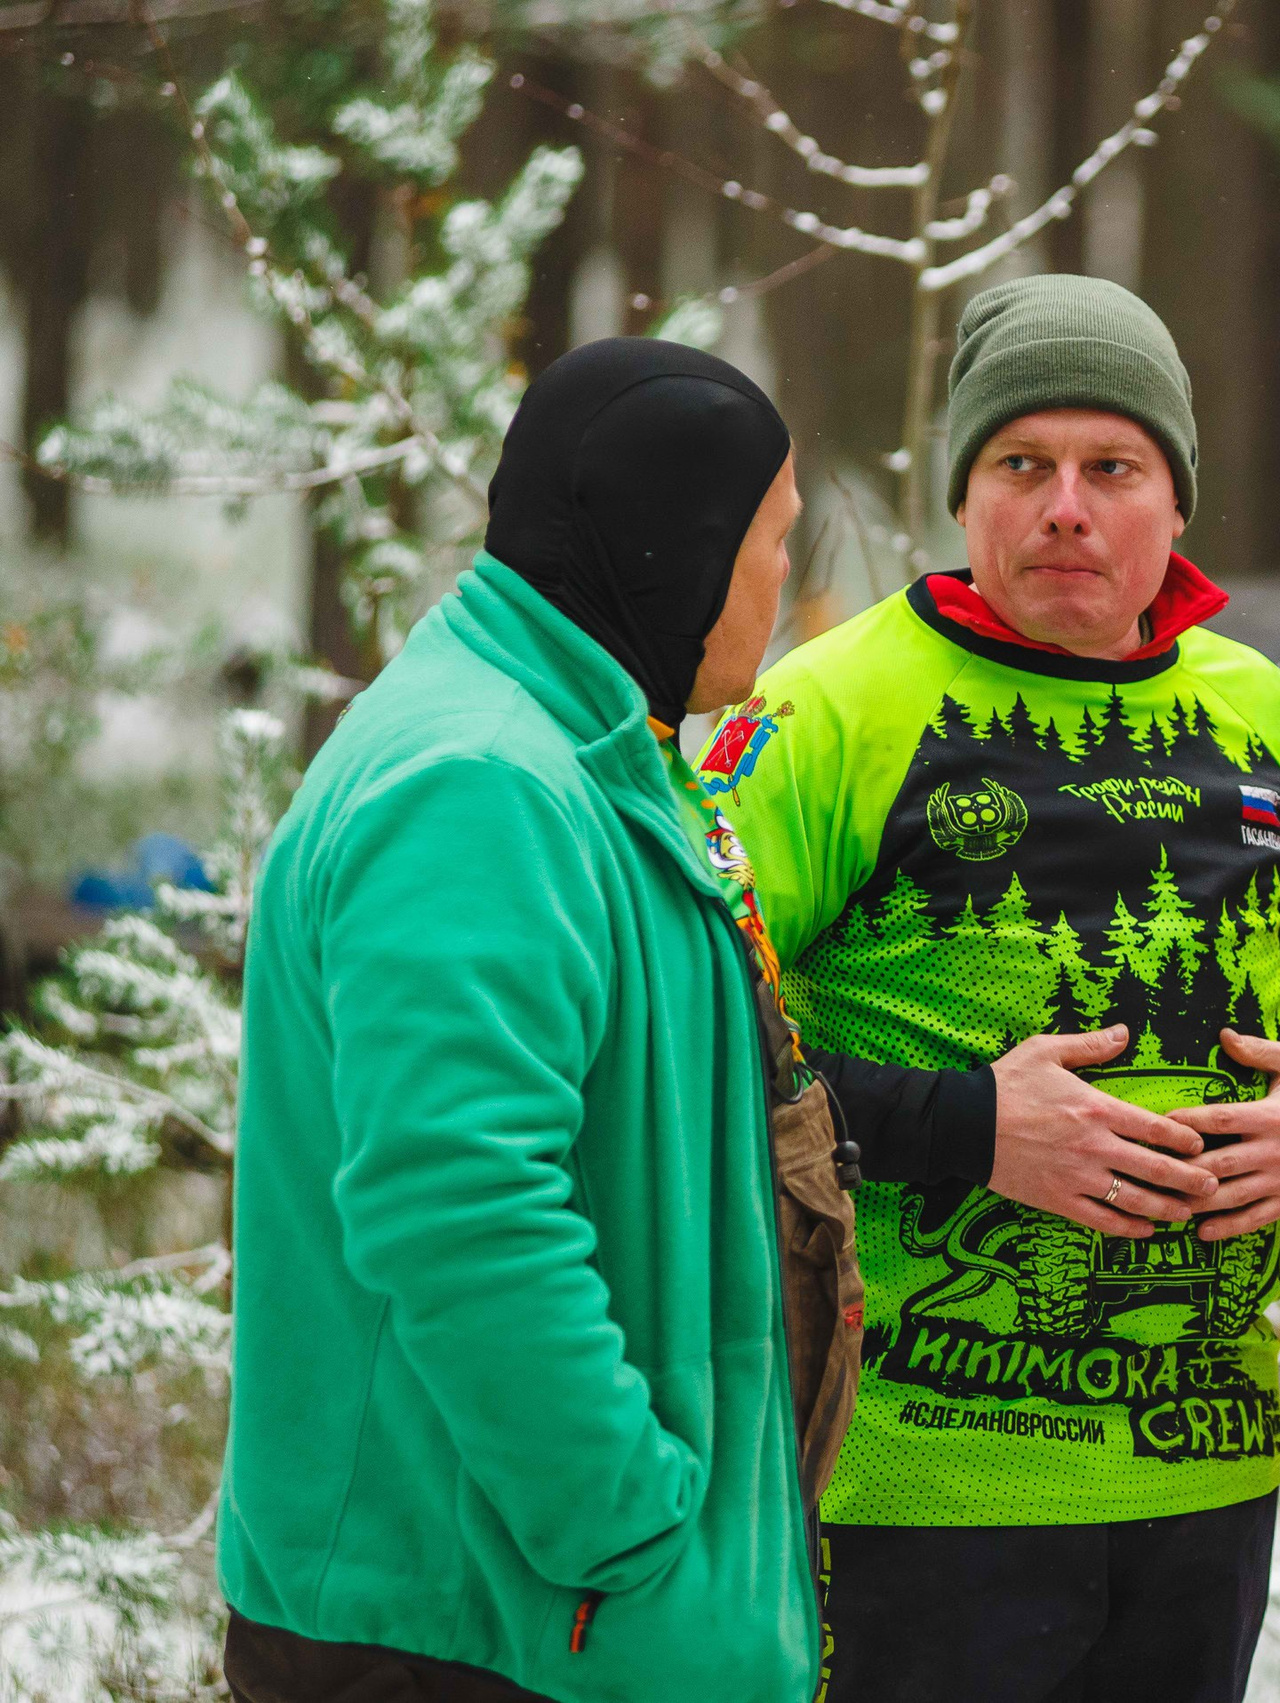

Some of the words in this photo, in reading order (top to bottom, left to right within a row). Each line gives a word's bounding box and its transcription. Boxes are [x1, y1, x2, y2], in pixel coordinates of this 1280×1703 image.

[1101, 793, 1185, 824] России
[906, 1327, 1180, 1399] KIKIMORA
[899, 1400, 1106, 1446] #СДЕЛАНОВРОССИИ
[1139, 1397, 1265, 1453] CREW
